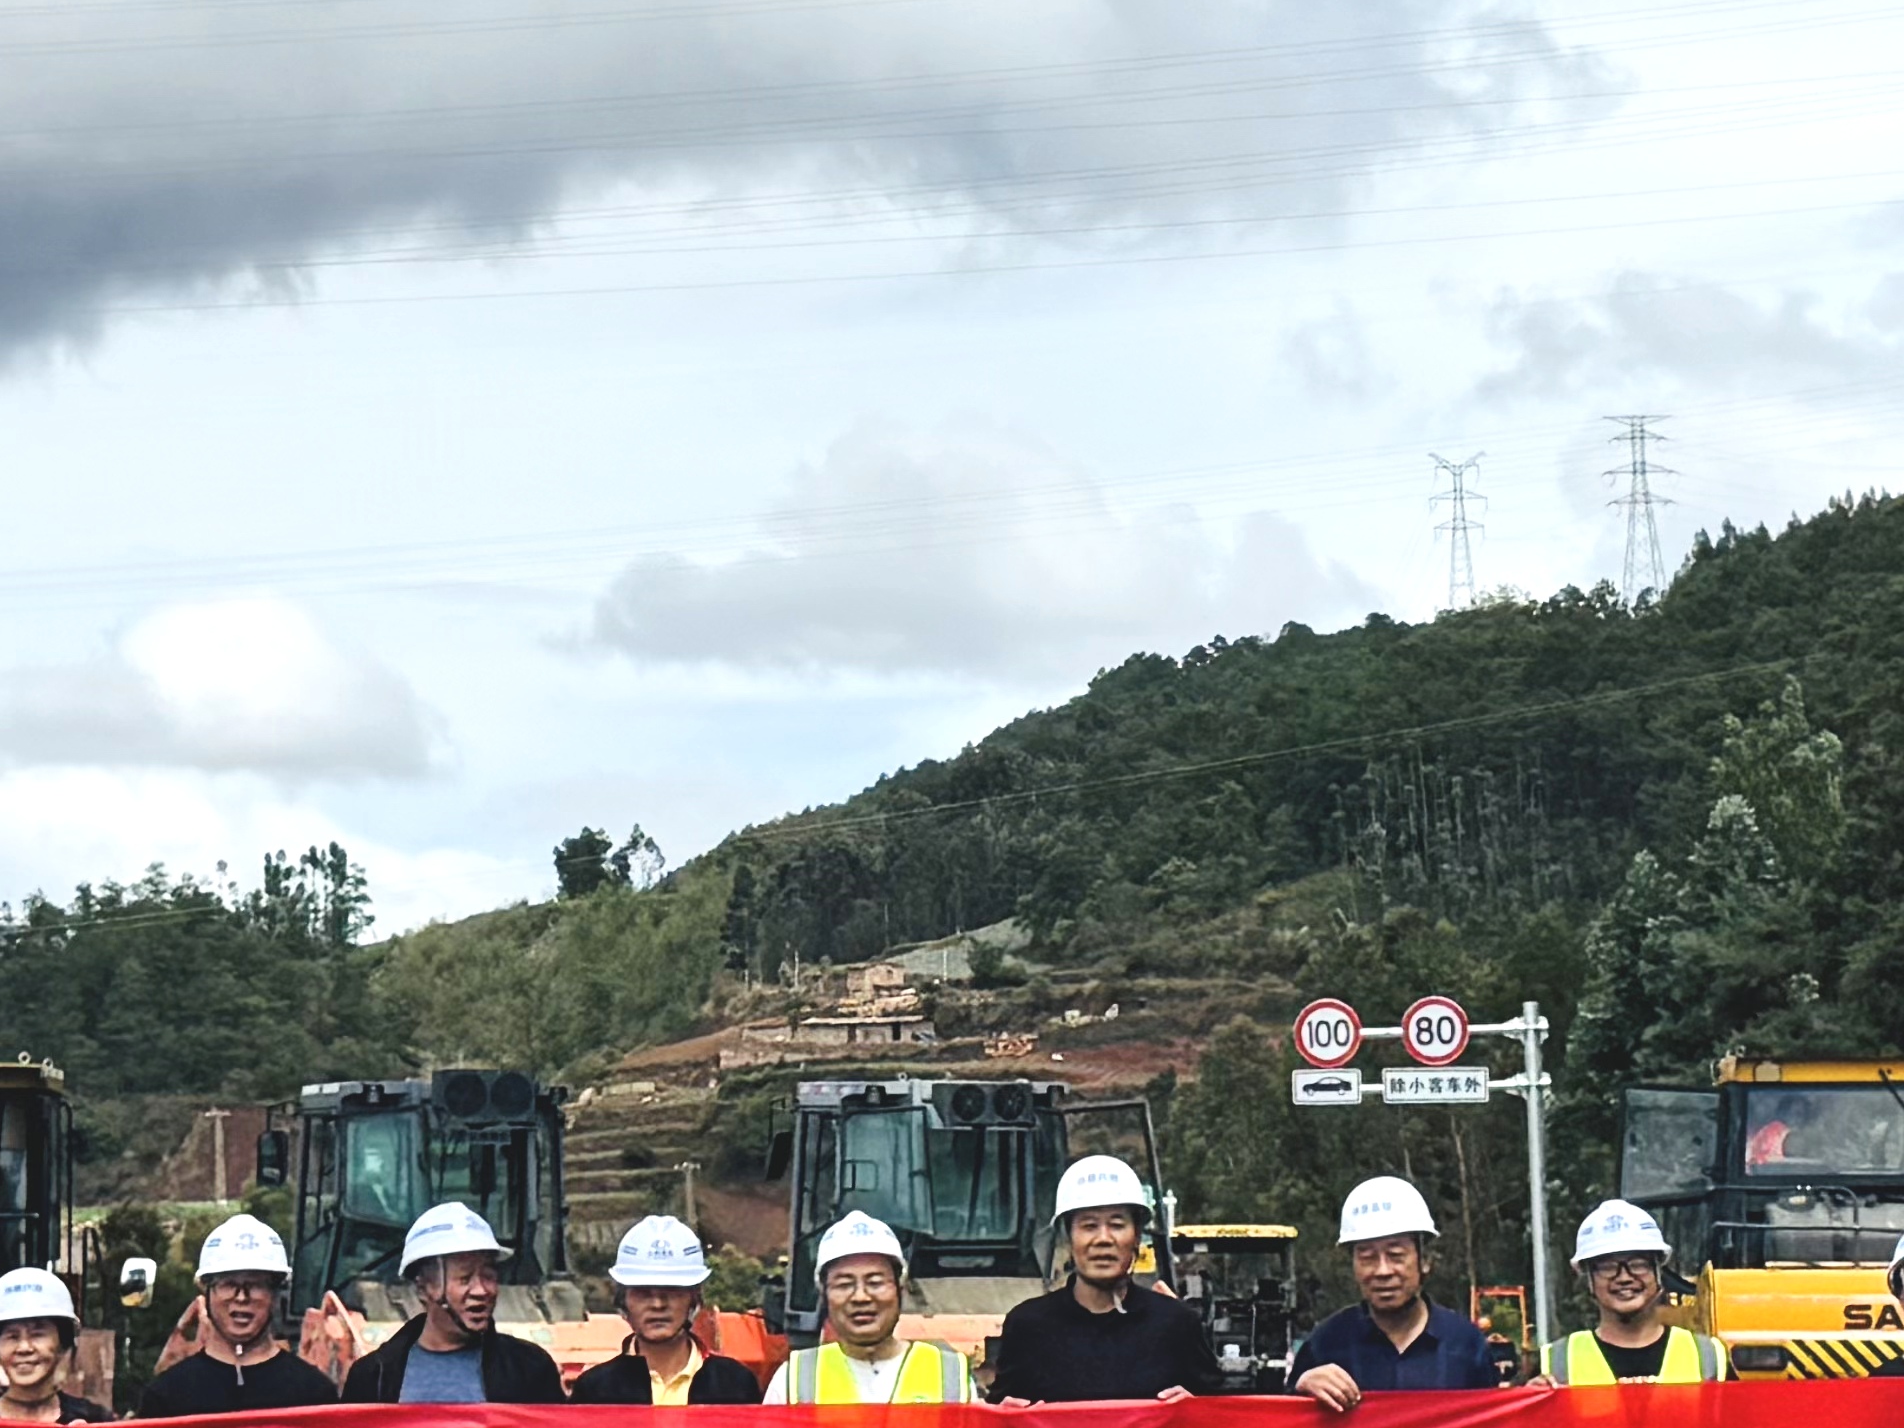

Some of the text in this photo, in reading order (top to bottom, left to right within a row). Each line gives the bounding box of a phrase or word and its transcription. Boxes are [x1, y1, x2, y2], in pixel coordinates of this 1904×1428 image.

[1306, 1019, 1350, 1049] 100
[1415, 1016, 1456, 1046] 80
[1390, 1076, 1481, 1094] 除小客车外
